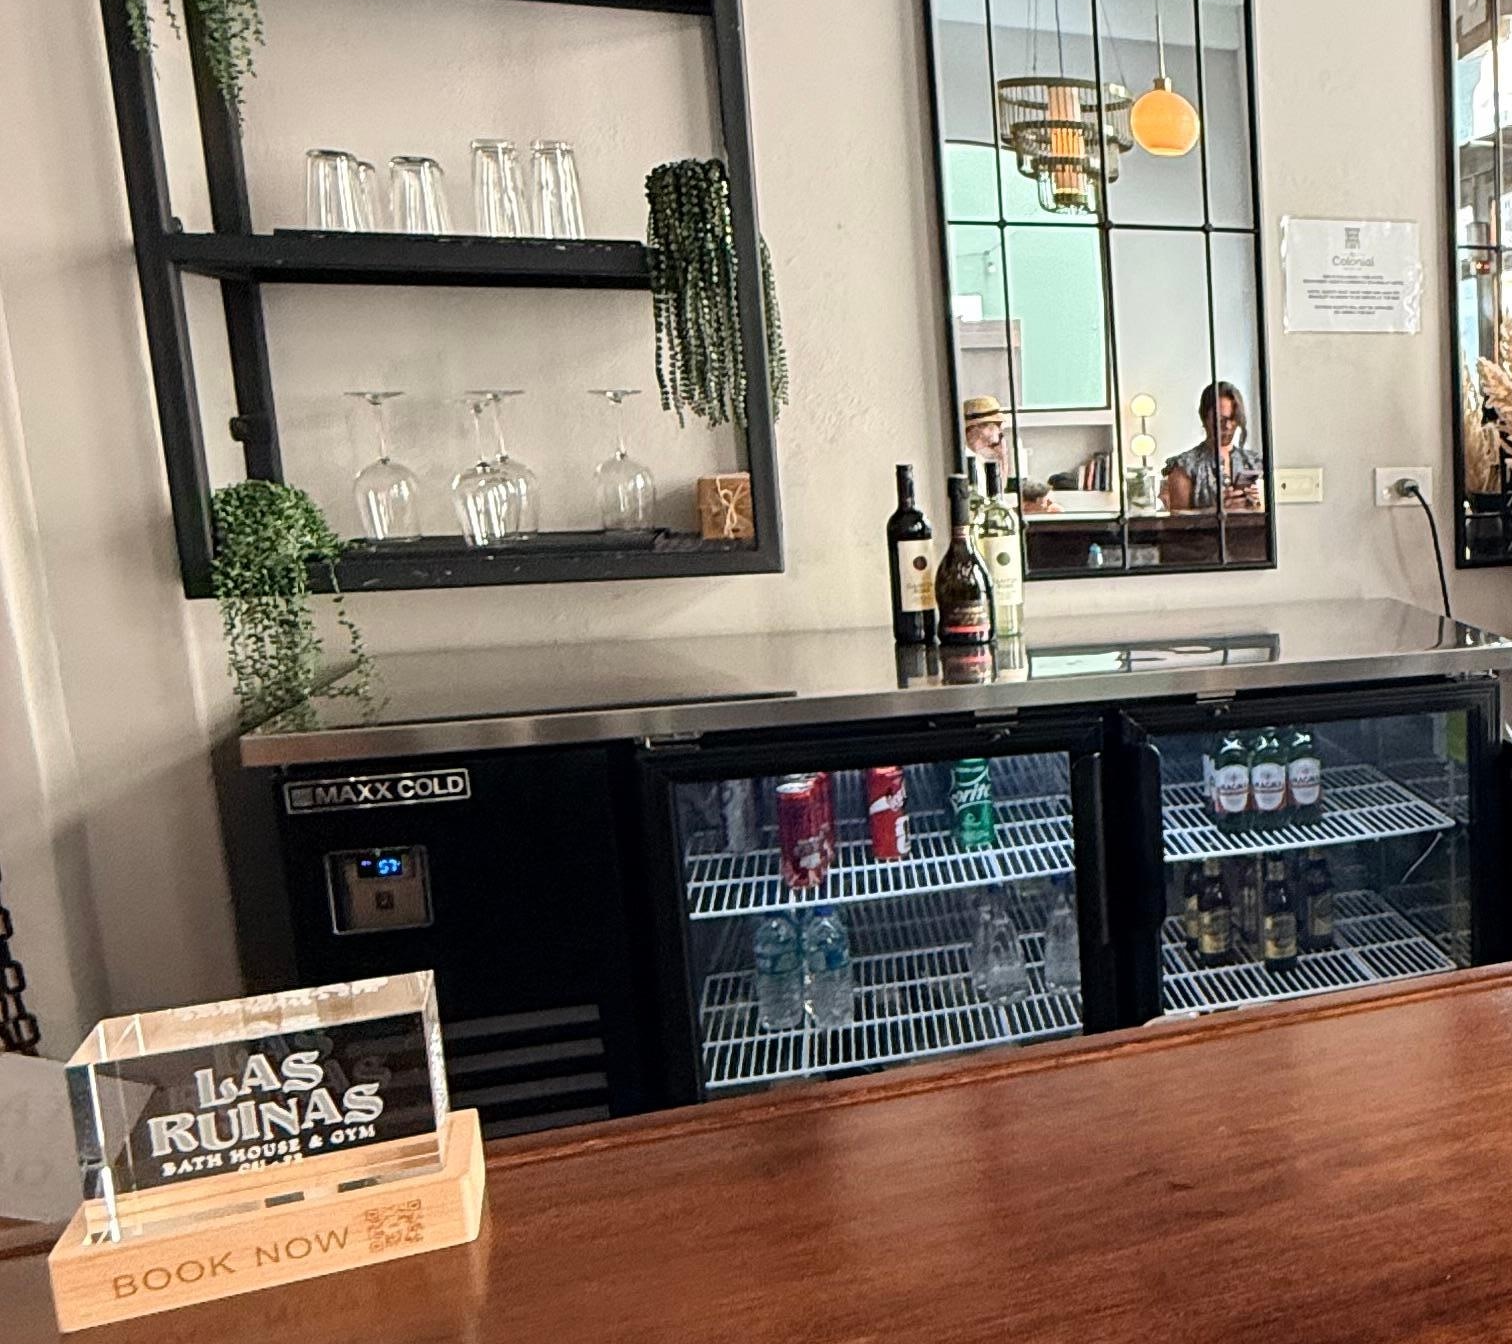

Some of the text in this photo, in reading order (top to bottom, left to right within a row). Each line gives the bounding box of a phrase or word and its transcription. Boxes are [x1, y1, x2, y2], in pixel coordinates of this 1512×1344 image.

[1332, 255, 1375, 267] Colonial
[314, 775, 464, 805] MAXX COLD
[193, 1050, 325, 1109] LAS
[146, 1082, 385, 1157] RUINAS
[160, 1153, 223, 1177] BATH
[229, 1138, 302, 1164] HOUSE
[308, 1134, 324, 1149] &
[330, 1123, 376, 1145] GYM
[111, 1226, 350, 1299] BOOK NOW
